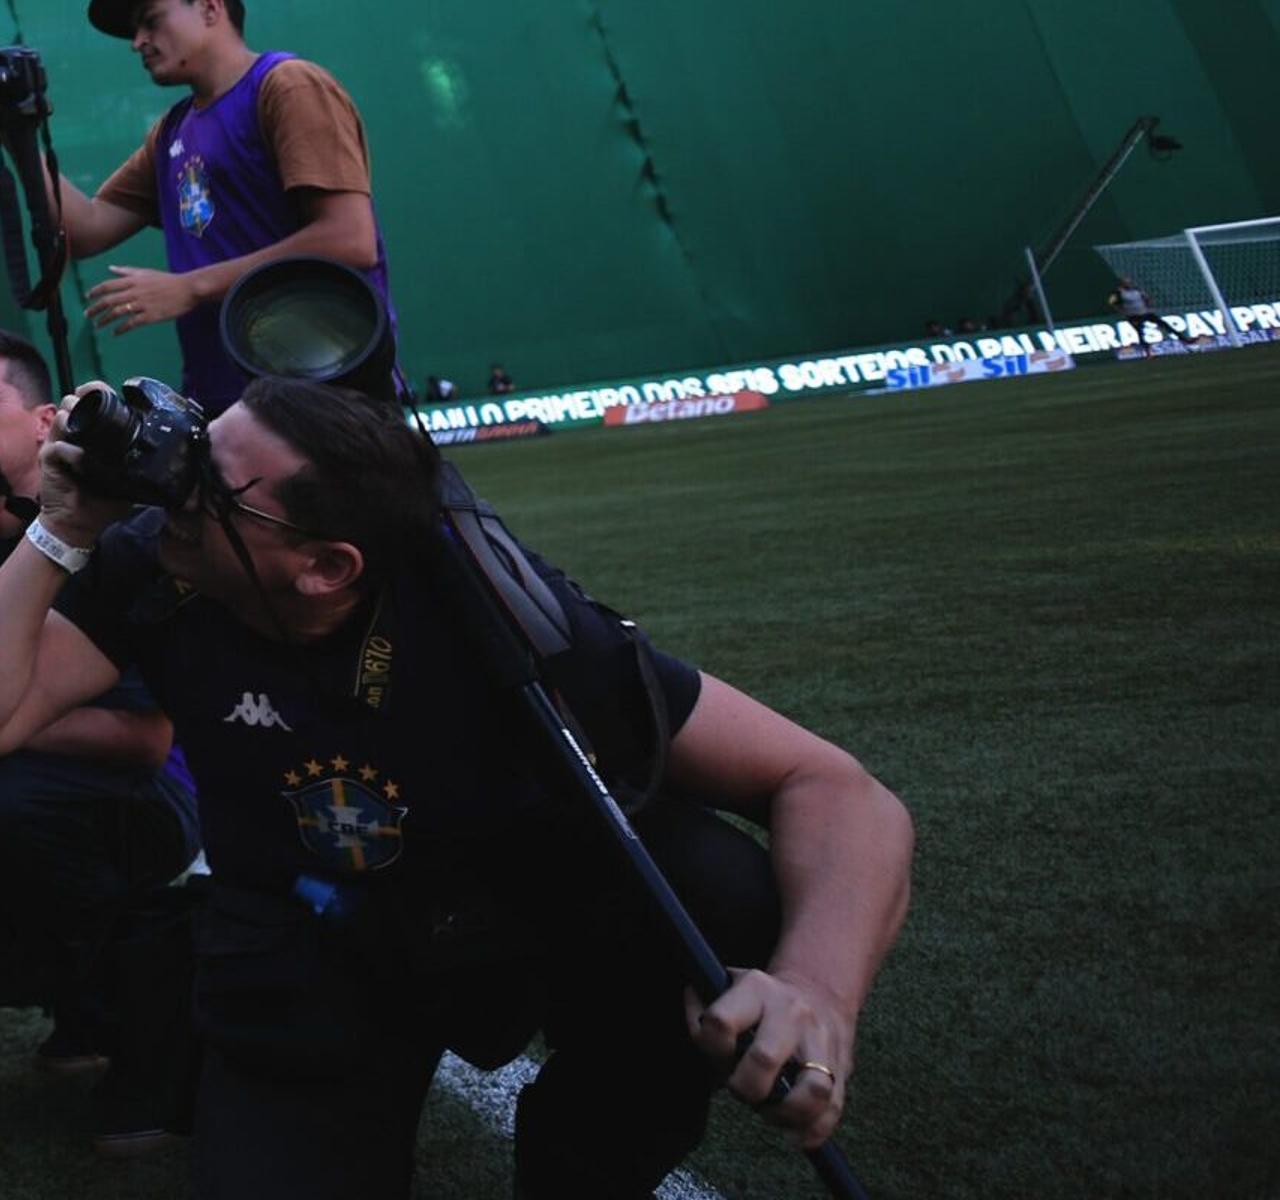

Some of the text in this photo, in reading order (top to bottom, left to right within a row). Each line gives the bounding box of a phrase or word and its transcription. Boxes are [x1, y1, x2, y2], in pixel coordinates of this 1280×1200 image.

[503, 384, 640, 424] PRIMEIRO
[641, 377, 706, 404] DOS
[778, 346, 930, 392] SORTEIOS
[887, 364, 931, 389] Sil
[624, 395, 736, 425] Betano
